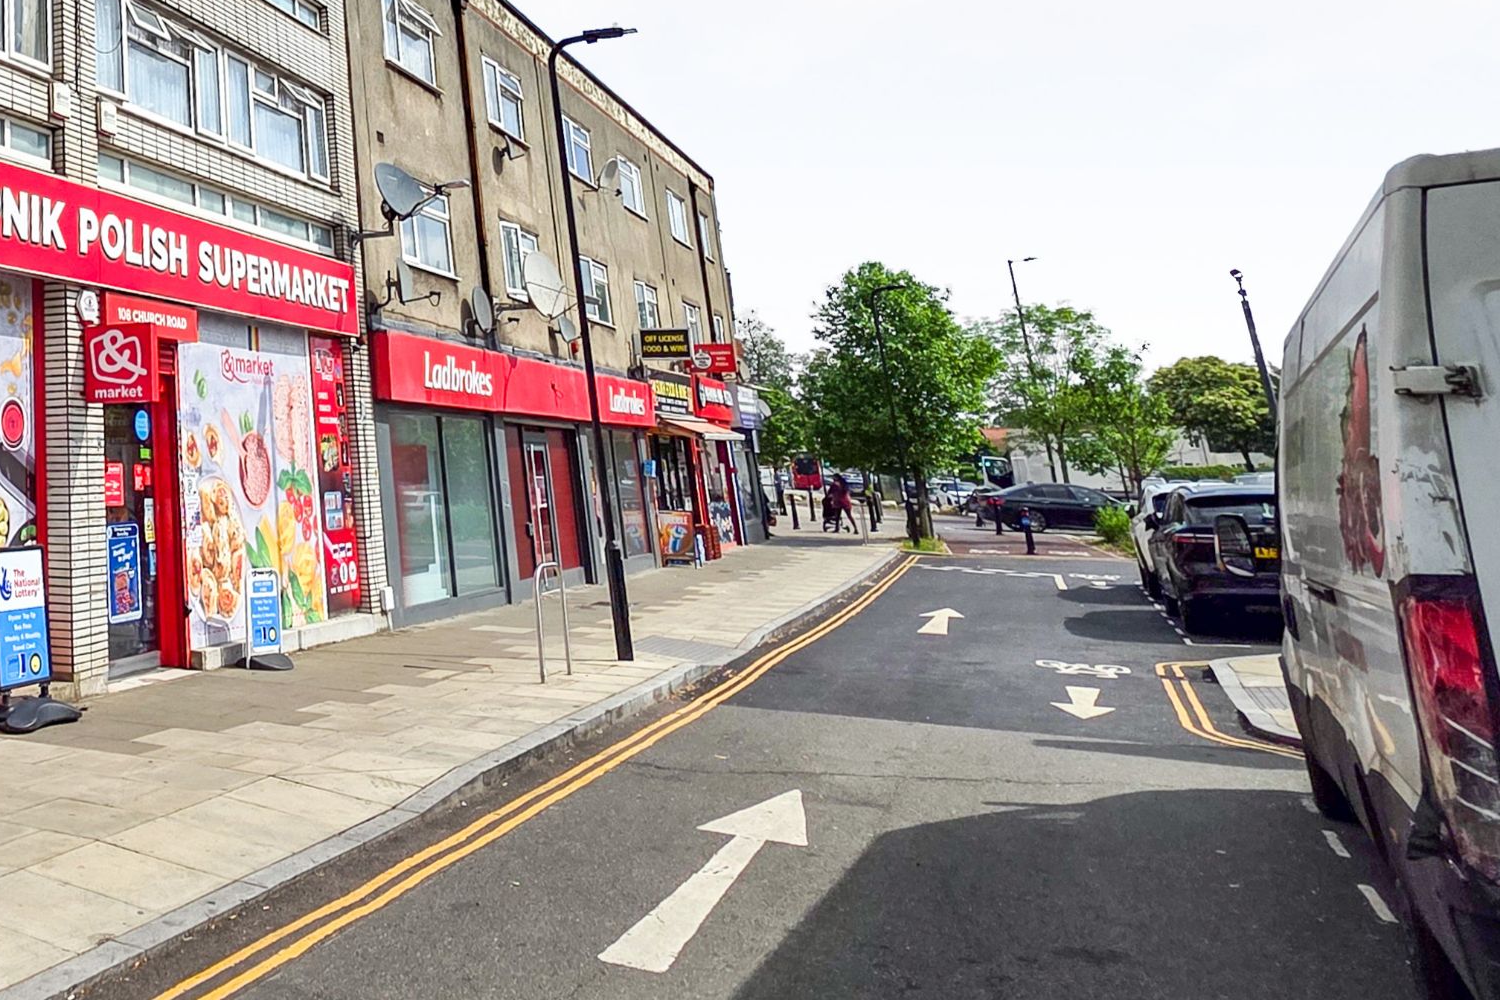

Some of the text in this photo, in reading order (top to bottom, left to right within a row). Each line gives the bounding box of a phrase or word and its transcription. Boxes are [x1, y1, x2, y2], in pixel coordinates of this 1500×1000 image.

[78, 206, 189, 277] POLISH
[198, 240, 349, 313] SUPERMARKET
[132, 309, 166, 327] CHURCH
[166, 314, 187, 329] ROAD
[658, 334, 685, 342] LICENSE
[670, 344, 688, 352] WINE
[424, 351, 493, 397] Ladbrokes
[95, 385, 143, 399] market
[609, 386, 645, 416] Ladbrokes
[13, 569, 25, 578] The
[14, 578, 40, 588] National
[14, 589, 39, 599] Lottery
